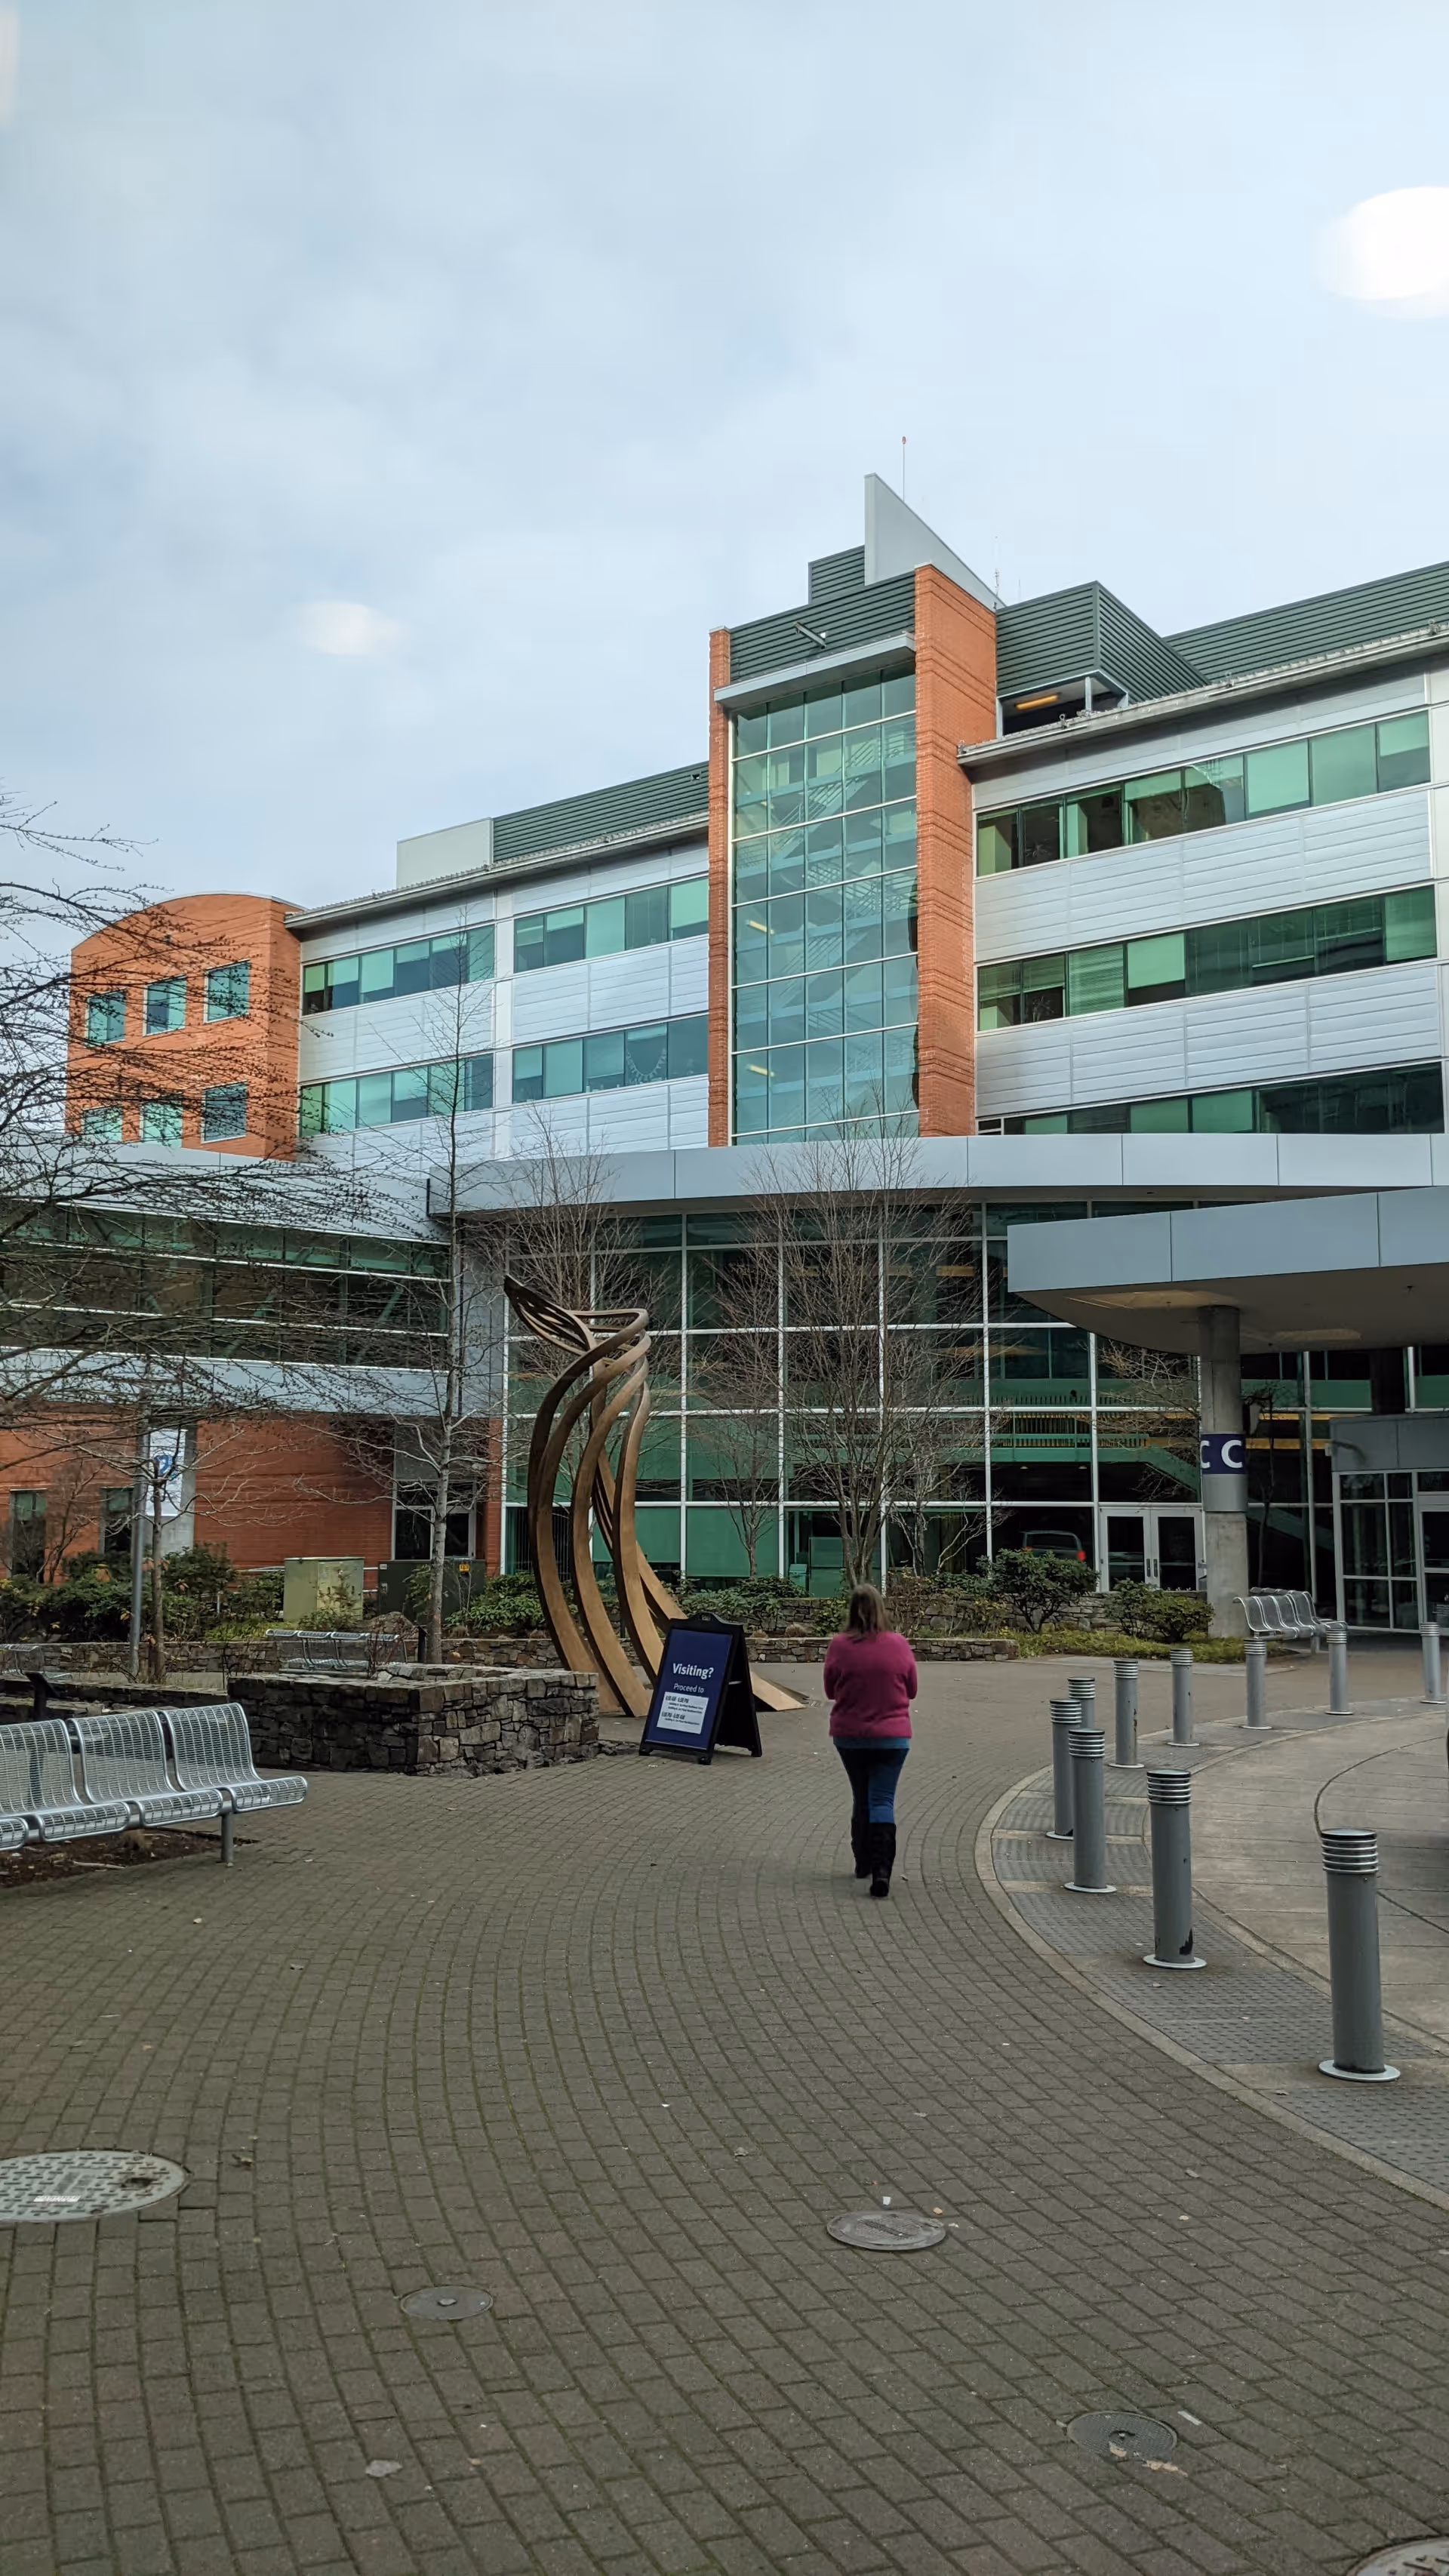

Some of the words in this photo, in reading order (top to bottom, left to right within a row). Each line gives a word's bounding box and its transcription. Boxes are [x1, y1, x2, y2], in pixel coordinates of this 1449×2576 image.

[1221, 1439, 1243, 1469] C
[673, 1663, 714, 1679] Visiting?
[673, 1683, 697, 1692] Proceed
